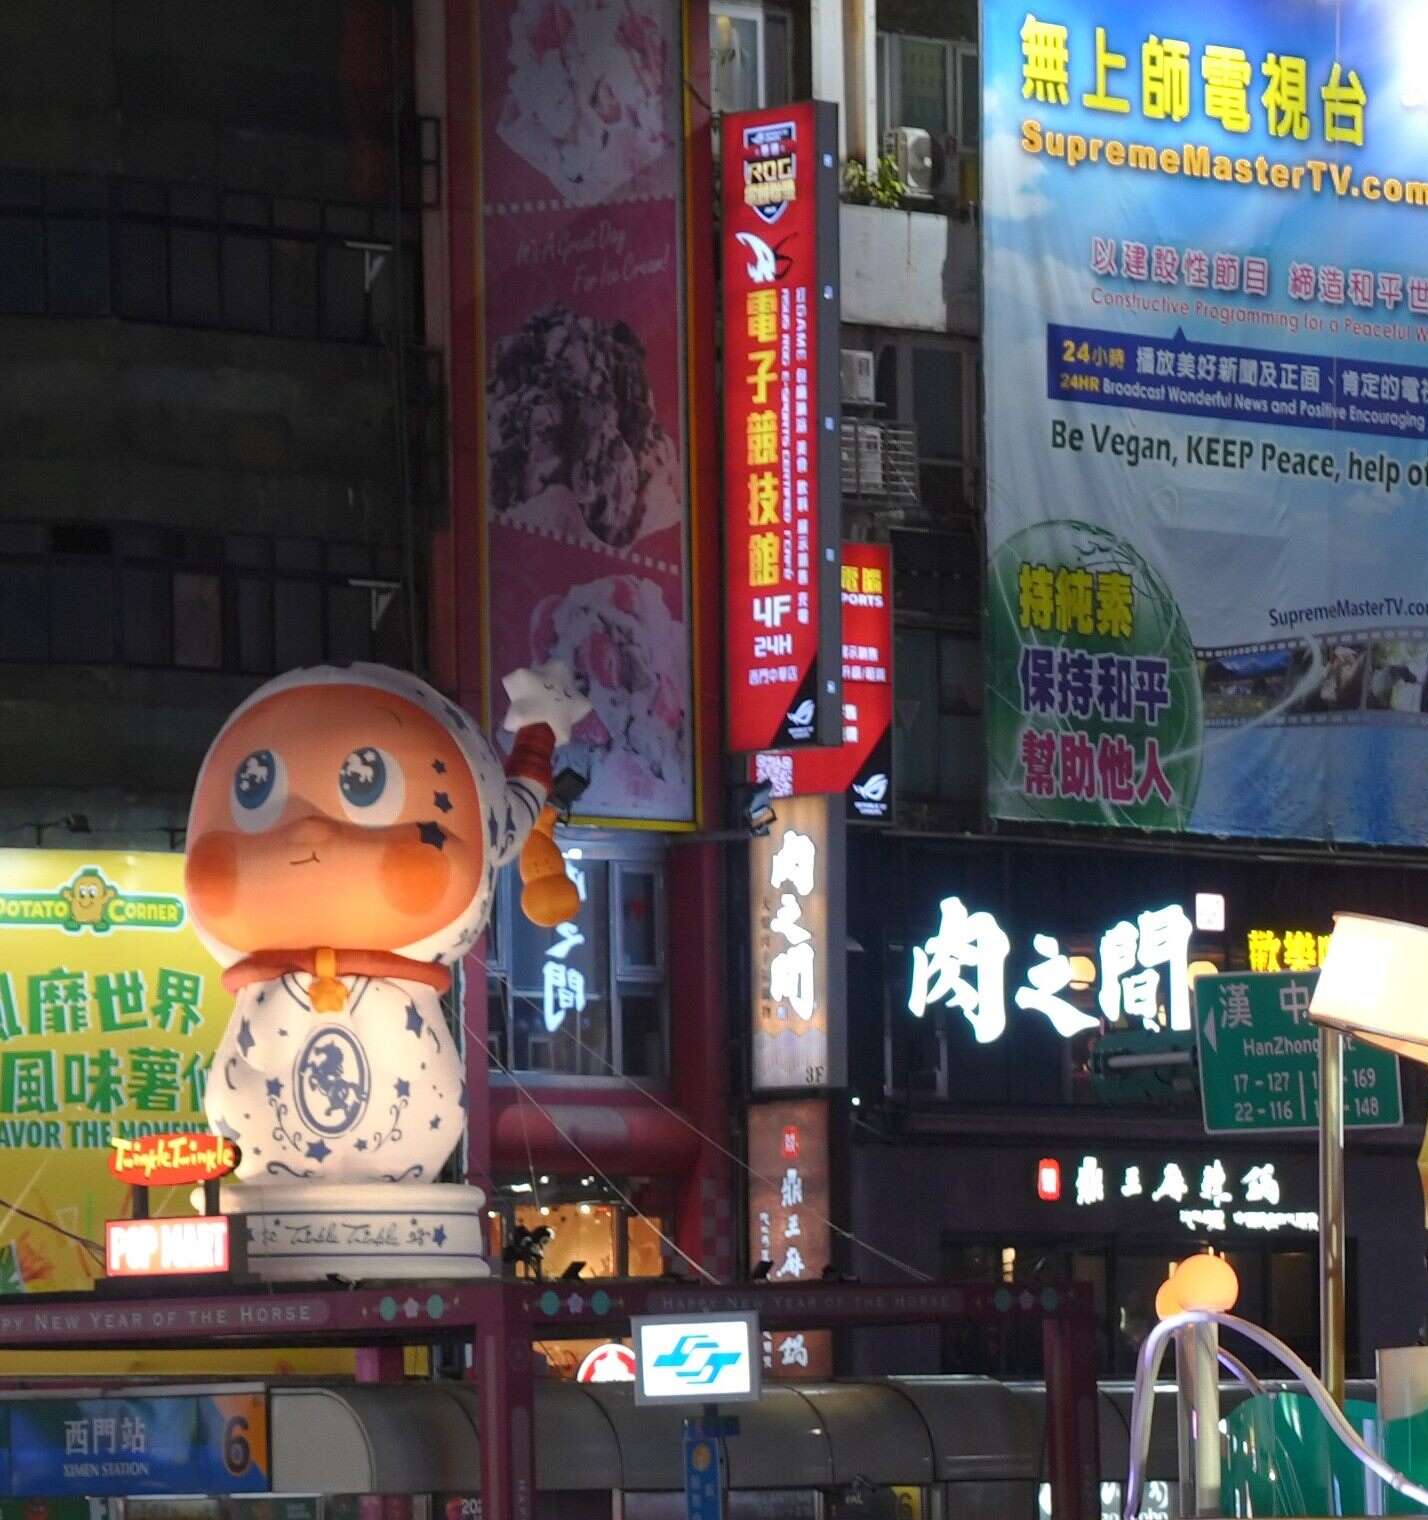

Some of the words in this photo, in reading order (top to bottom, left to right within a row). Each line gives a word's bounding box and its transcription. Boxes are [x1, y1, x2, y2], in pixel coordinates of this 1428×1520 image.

[1020, 14, 1367, 146] 無上師電視台
[1089, 236, 1270, 296] 以建設性節目
[1091, 288, 1189, 316] Constructive
[1195, 300, 1299, 333] Programming
[1303, 313, 1322, 332] for
[1344, 317, 1410, 341] Peaceful
[1060, 372, 1100, 392] 24HR
[1103, 378, 1166, 401] Broadcast
[1169, 385, 1234, 409] Wonderful
[1236, 393, 1269, 415] News
[1271, 399, 1297, 416] and
[1300, 401, 1346, 420] Positive
[1349, 406, 1426, 432] Encouraging
[746, 288, 781, 587] 電子競技館
[1051, 420, 1084, 452] Be
[1091, 423, 1178, 466] Vegan,
[1186, 434, 1254, 468] KEEP
[1261, 442, 1340, 484] Peace,
[1348, 450, 1400, 493] help
[752, 595, 792, 628] 4F
[1018, 561, 1136, 640] 持純素
[754, 633, 793, 657] 24H
[1018, 645, 1172, 725] 保持和平
[1020, 730, 1174, 808] 幫助他人
[107, 895, 178, 922] CORNER
[908, 896, 1193, 1043] 肉之間
[805, 1064, 825, 1085] 3F
[1267, 1072, 1290, 1094] 127
[1352, 1068, 1377, 1090] 169
[68, 1121, 112, 1148] THE
[1270, 1101, 1294, 1121] 116
[1354, 1096, 1380, 1118] 148
[777, 1167, 808, 1368] 鼎王麻鍋
[34, 1312, 79, 1332] NEW
[89, 1310, 143, 1329] YEAR
[152, 1308, 178, 1328] OF
[187, 1308, 228, 1325] THE
[240, 1304, 312, 1323] HORSE
[63, 1416, 146, 1457] 西門站
[223, 1415, 250, 1477] 6
[102, 1460, 150, 1478] STATION
